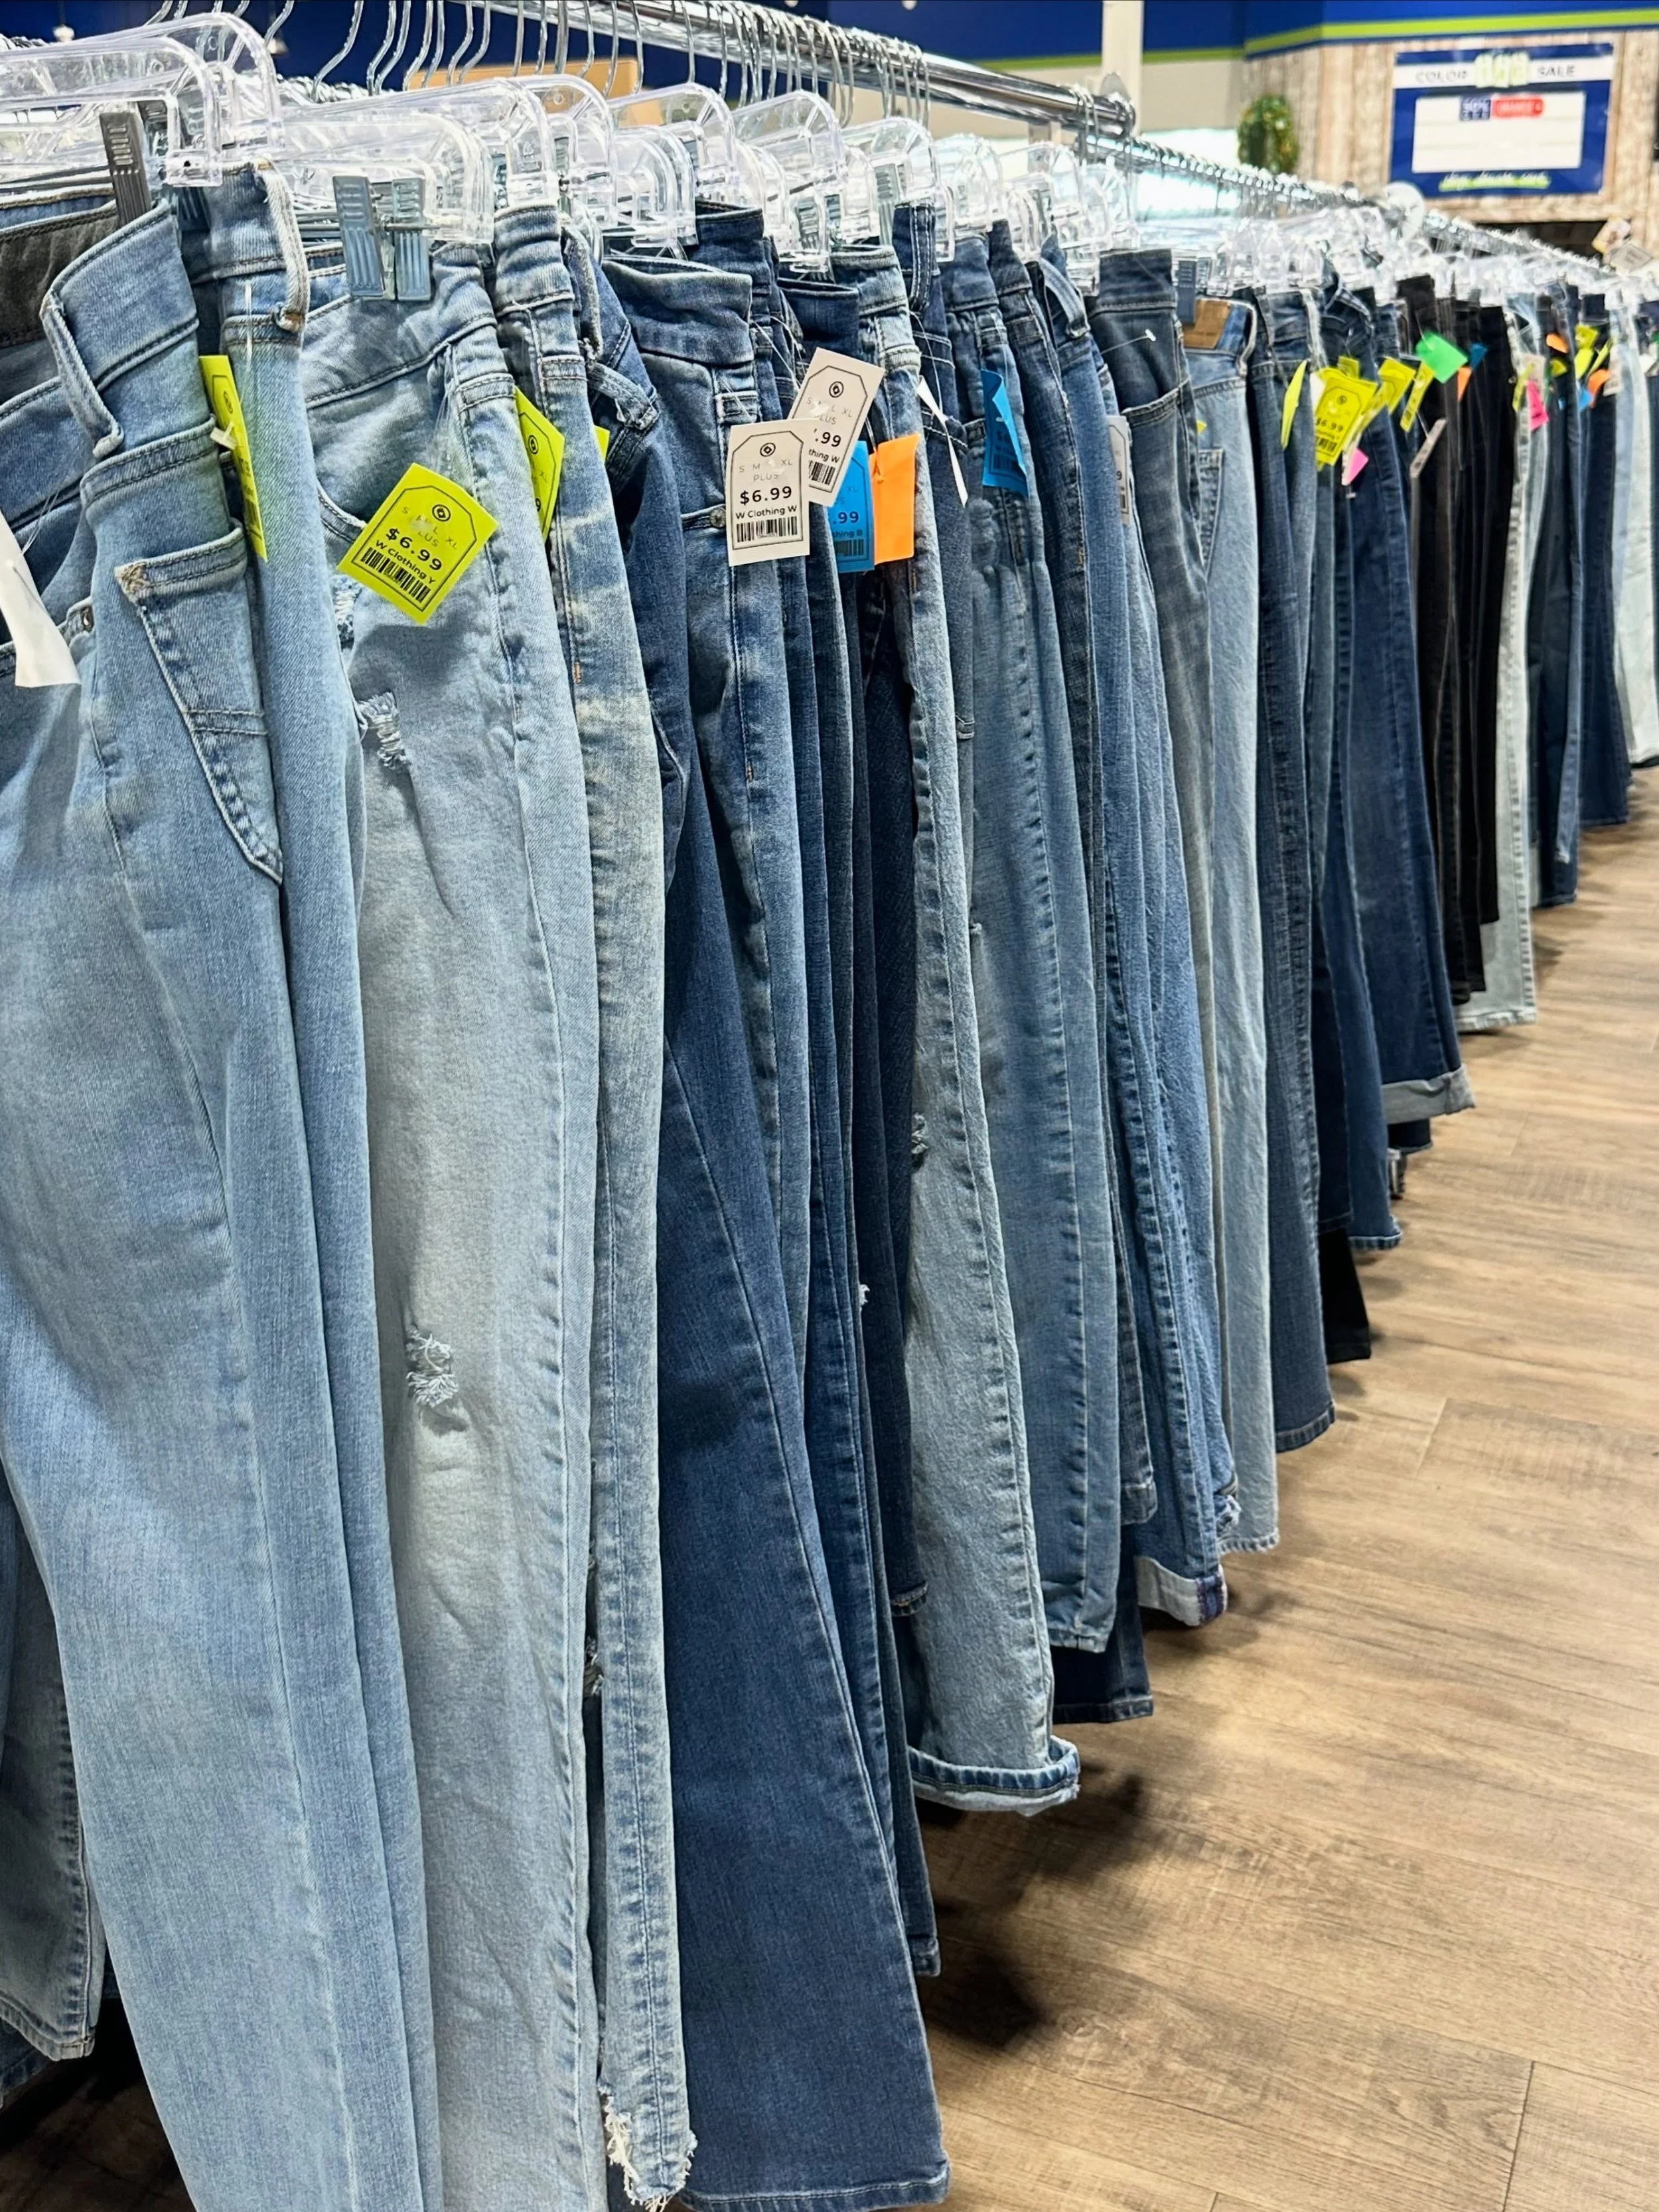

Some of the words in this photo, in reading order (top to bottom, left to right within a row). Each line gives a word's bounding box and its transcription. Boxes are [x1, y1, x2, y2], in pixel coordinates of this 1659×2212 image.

[1415, 70, 1467, 83] COLOR
[1537, 66, 1575, 77] SALE
[841, 407, 853, 417] XL
[808, 449, 829, 462] thing
[831, 455, 841, 463] W
[740, 486, 792, 506] $6.99
[735, 511, 745, 520] W
[747, 507, 786, 518] Clothing
[833, 510, 859, 524] .99
[386, 528, 442, 571] $6.99
[376, 540, 387, 550] W
[388, 548, 427, 579] Clothing
